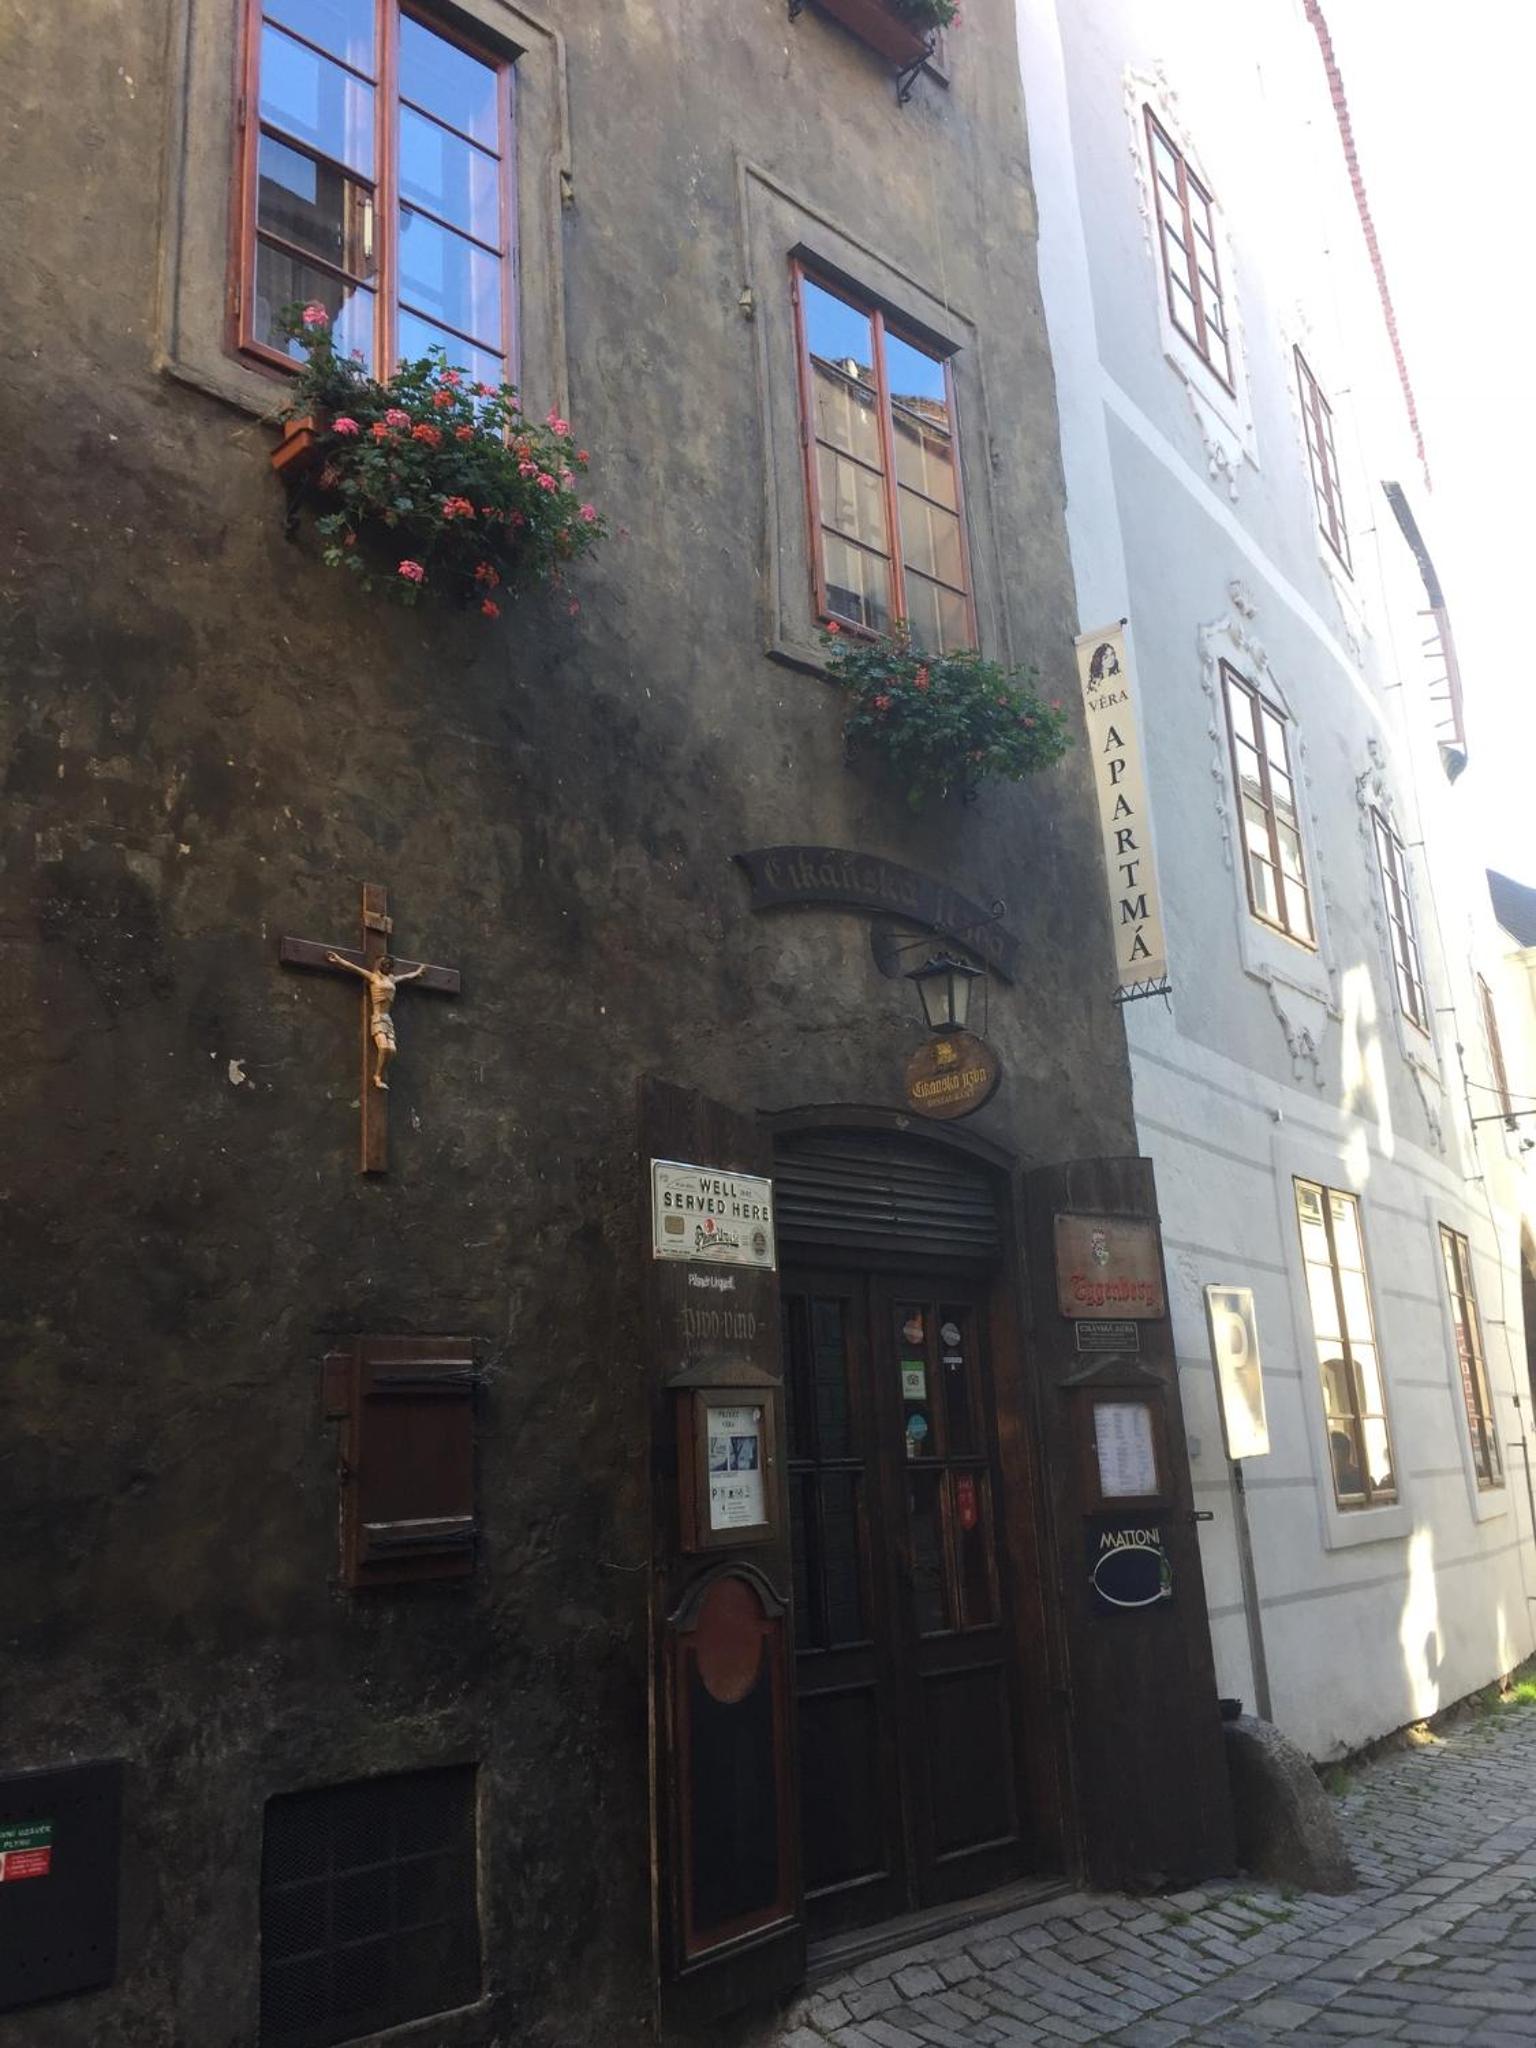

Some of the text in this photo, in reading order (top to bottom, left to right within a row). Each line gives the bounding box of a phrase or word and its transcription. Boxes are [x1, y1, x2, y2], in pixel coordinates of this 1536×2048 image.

[700, 1177, 737, 1198] WELL
[664, 1191, 726, 1214] SERVED
[732, 1202, 769, 1221] HERE
[1100, 1528, 1160, 1550] MATTONI
